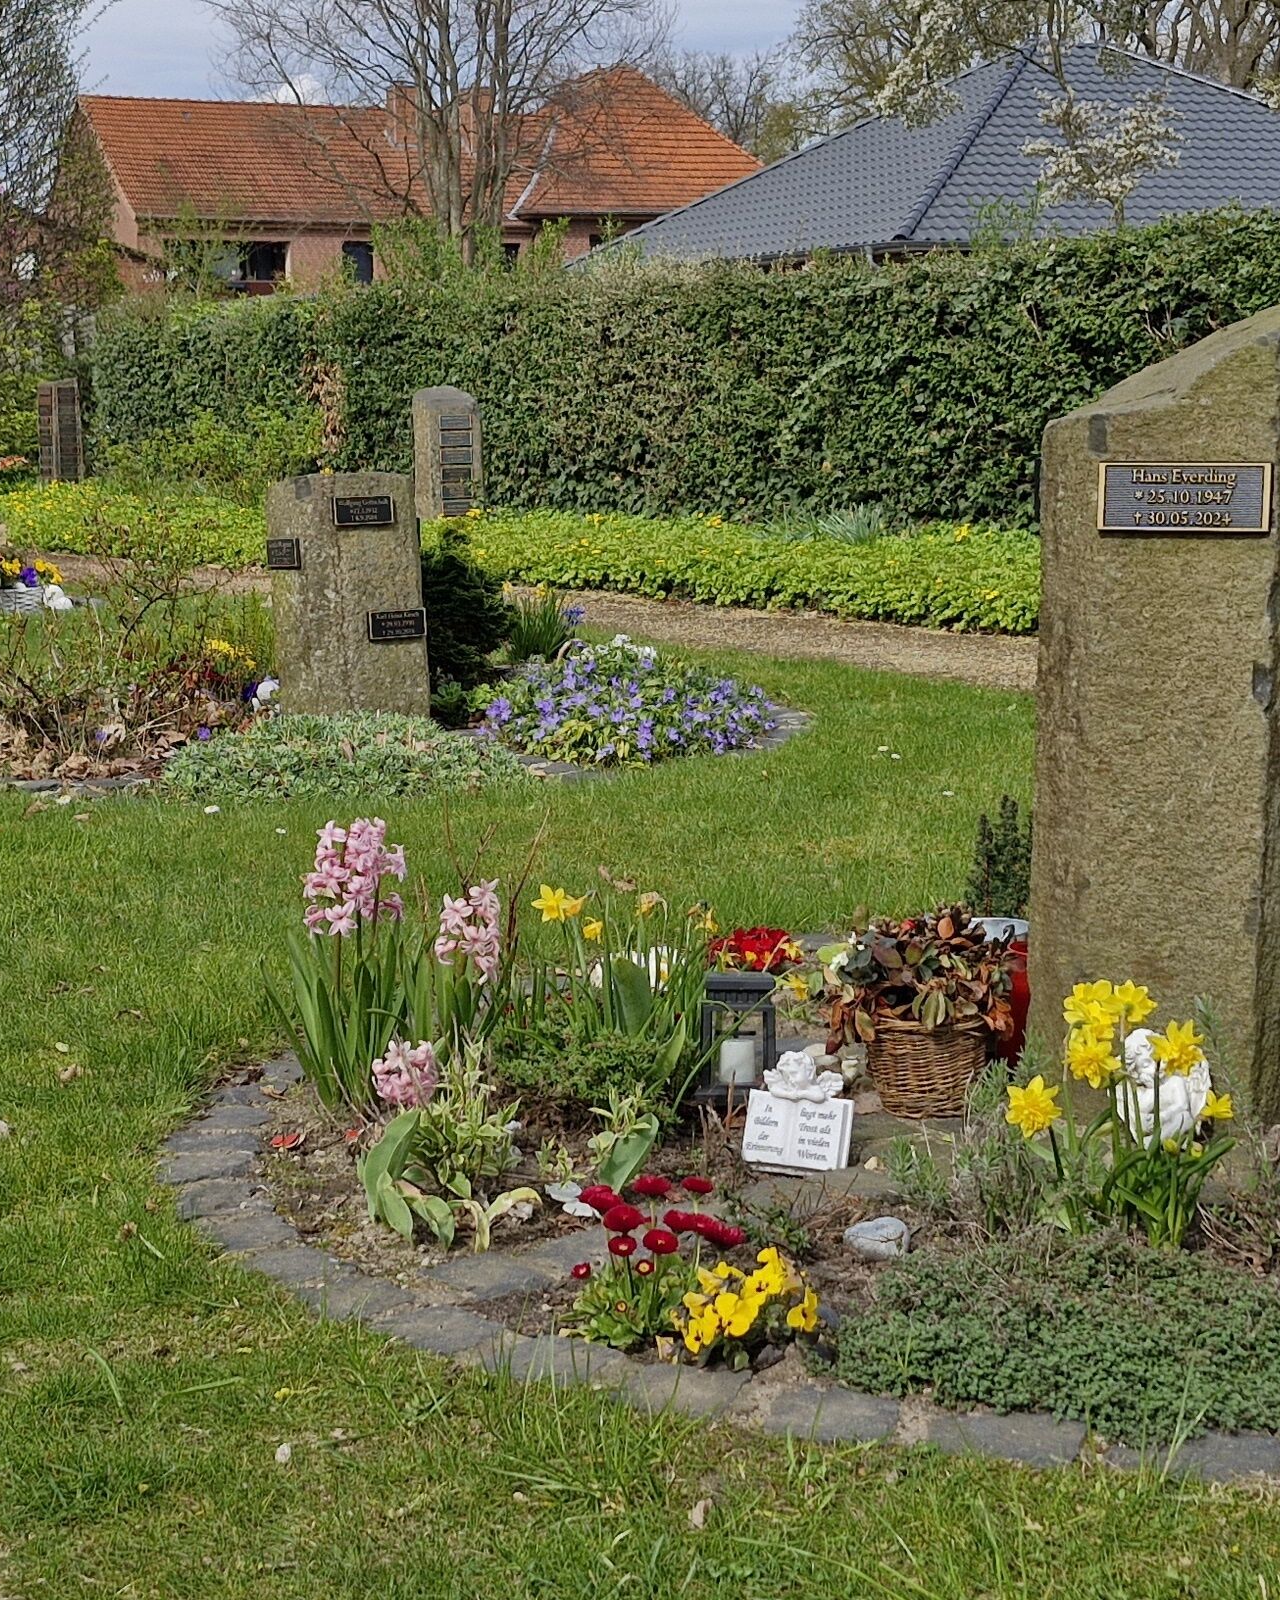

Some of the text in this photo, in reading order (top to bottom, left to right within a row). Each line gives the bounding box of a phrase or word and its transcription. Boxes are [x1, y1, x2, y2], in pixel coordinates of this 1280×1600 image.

[1131, 467, 1237, 489] Hans Everding
[1147, 488, 1233, 504] 25.10.1947
[1147, 510, 1233, 527] 30.05.2024
[818, 1110, 837, 1120] mehr
[758, 1131, 769, 1140] der
[799, 1122, 831, 1135] Trost als
